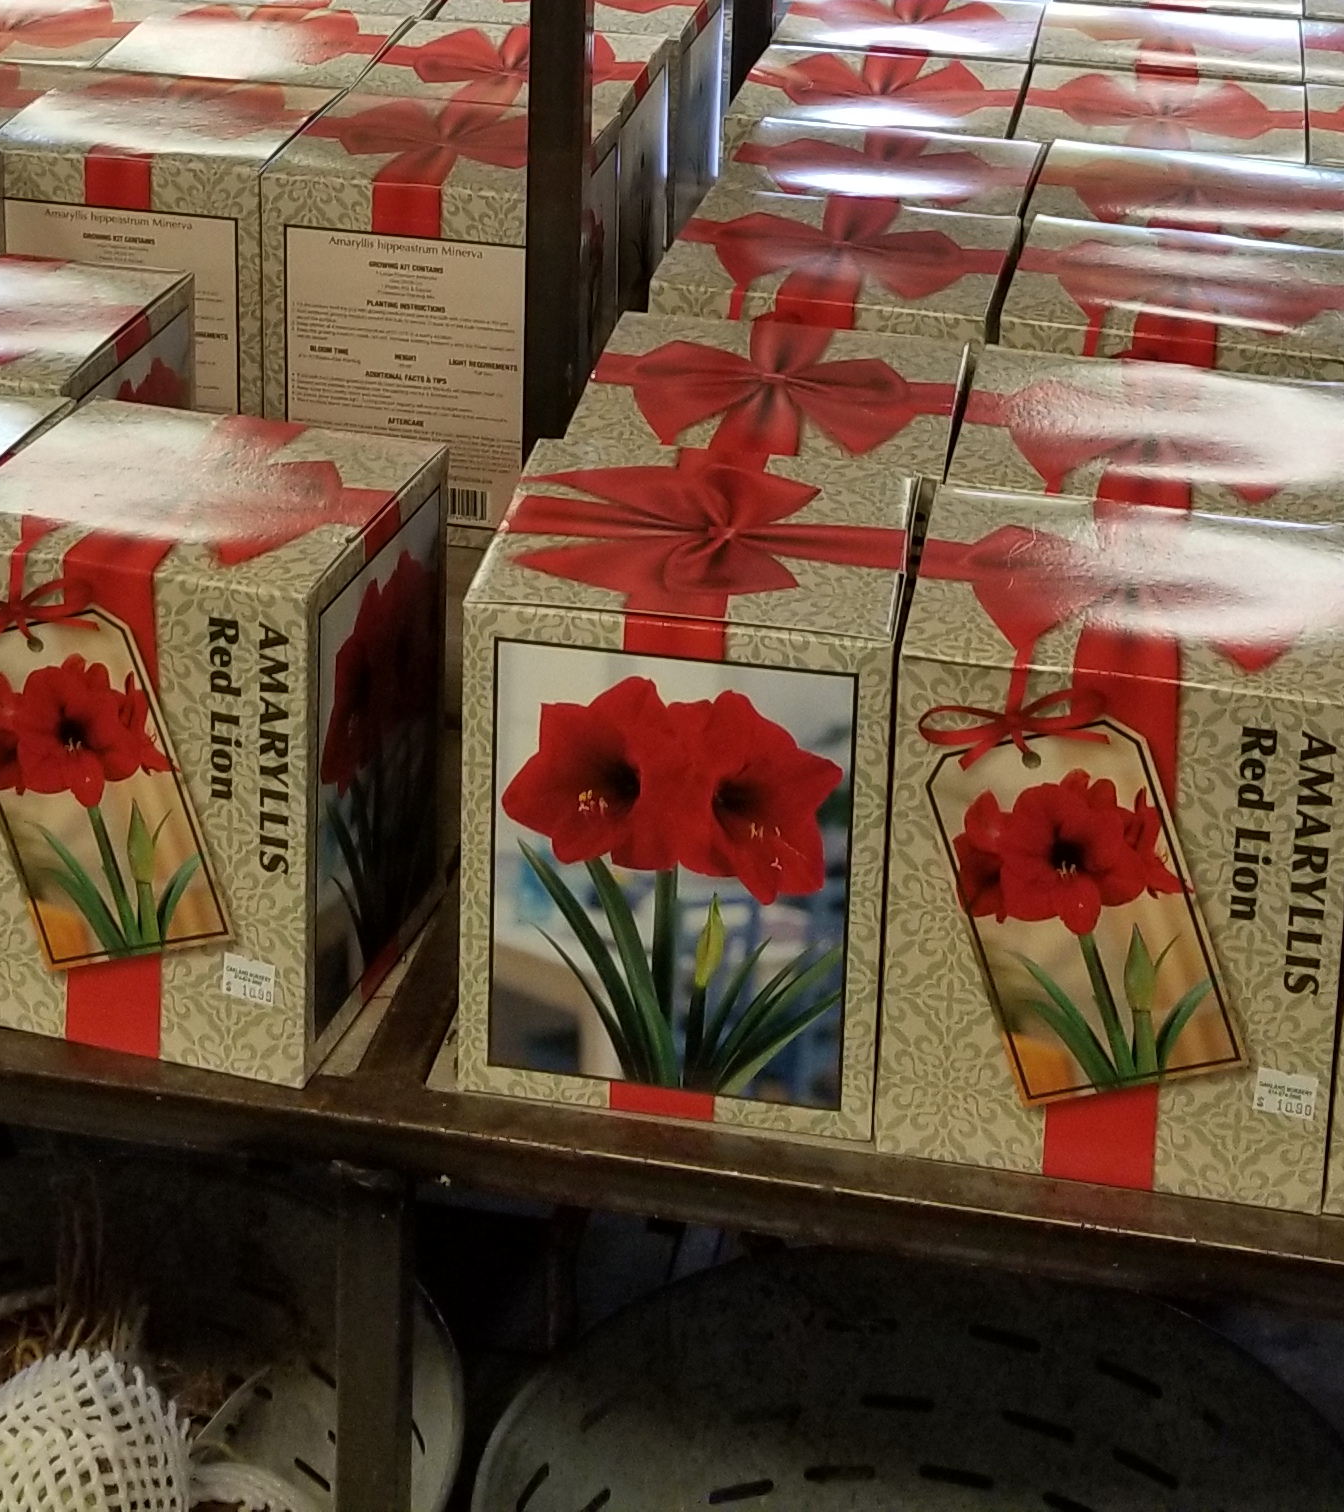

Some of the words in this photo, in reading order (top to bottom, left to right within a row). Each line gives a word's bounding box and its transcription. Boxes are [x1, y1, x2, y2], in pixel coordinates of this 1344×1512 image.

[44, 208, 88, 221] Amaryllis
[90, 212, 150, 227] hippeastrum
[152, 218, 194, 231] Minerva
[328, 236, 374, 250] Amaryllis
[377, 239, 438, 256] hippeastrum
[441, 245, 484, 260] Minerva
[366, 299, 399, 311] PLANTING
[207, 616, 241, 701] Red
[210, 715, 242, 801] Lion
[257, 620, 290, 876] AMARYLLIS
[1236, 726, 1278, 812] Red
[1229, 831, 1272, 921] Lion
[1282, 729, 1338, 997] AMARYLLIS
